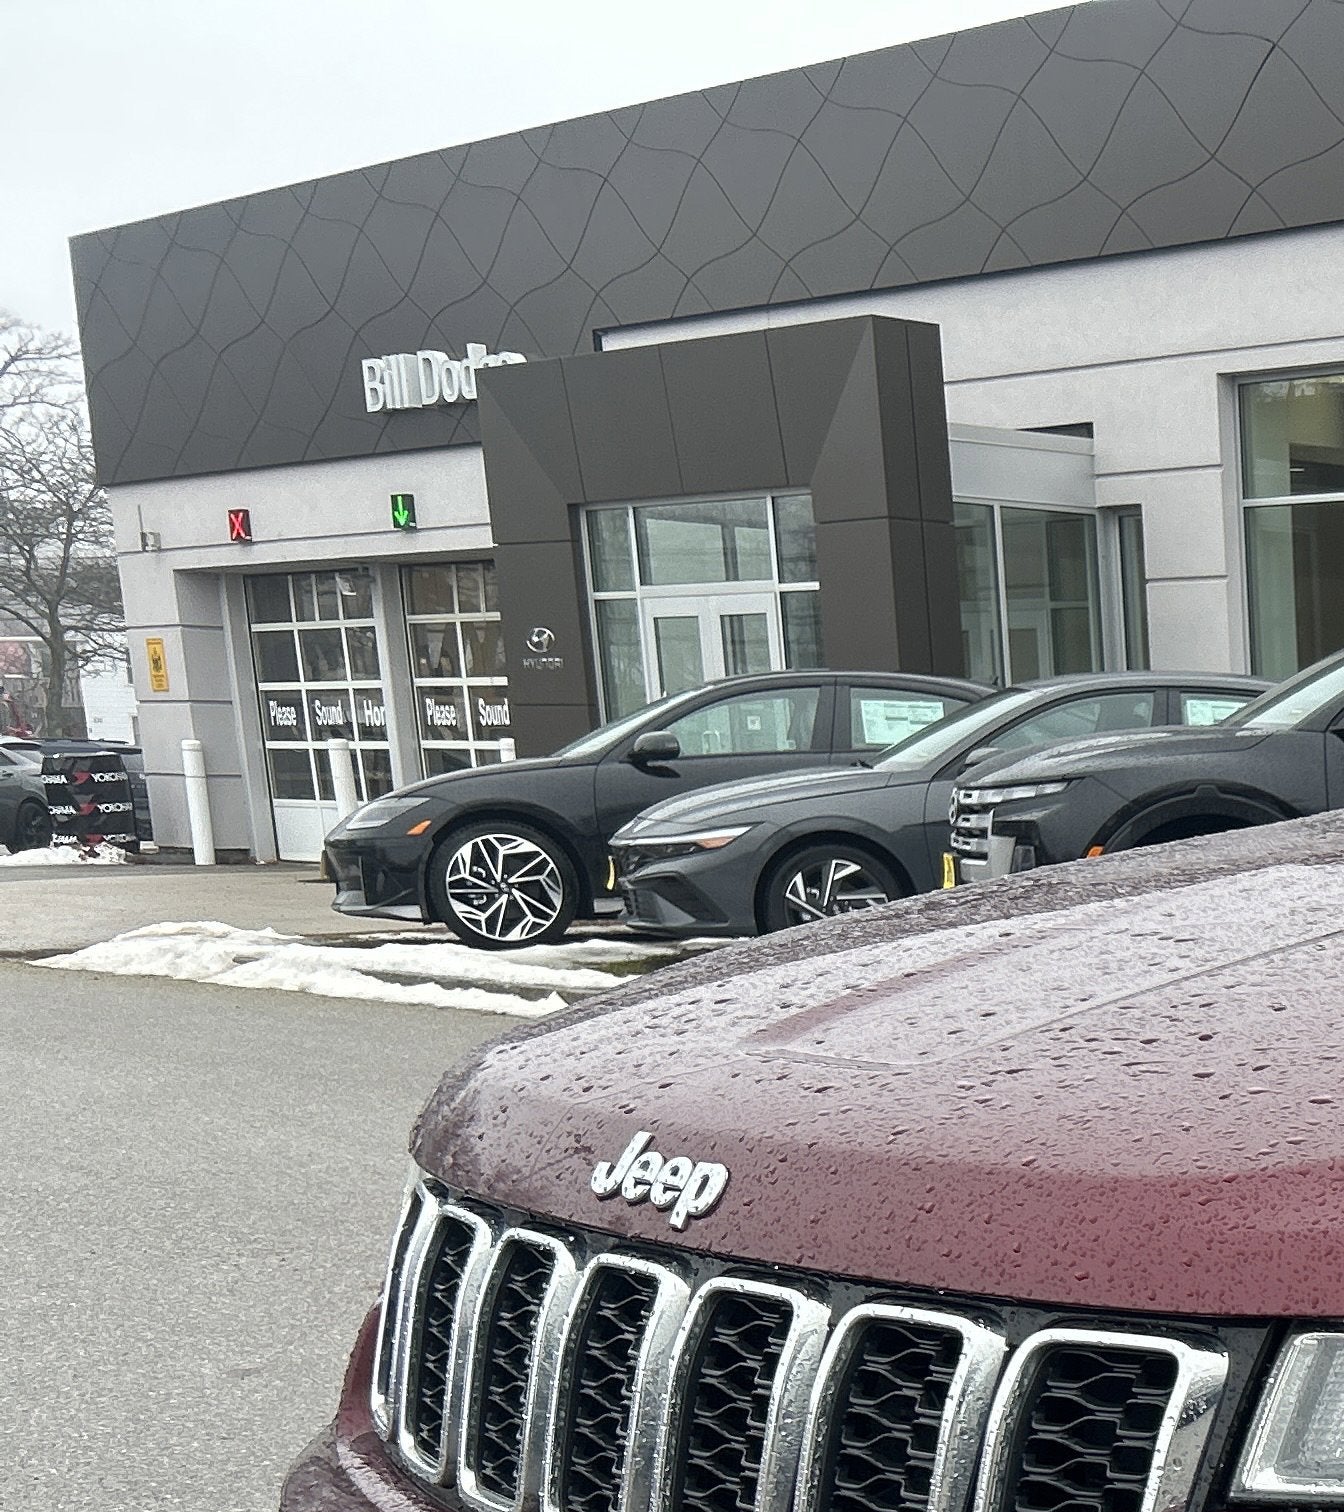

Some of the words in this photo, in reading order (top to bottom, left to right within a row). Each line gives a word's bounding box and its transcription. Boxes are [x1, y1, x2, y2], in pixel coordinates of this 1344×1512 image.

[361, 353, 421, 413] Bill
[416, 342, 528, 406] Dod
[269, 700, 297, 726] Please
[314, 700, 344, 726] Sound
[425, 698, 457, 726] Please
[478, 698, 511, 727] Sound
[590, 1130, 730, 1231] Jeep
